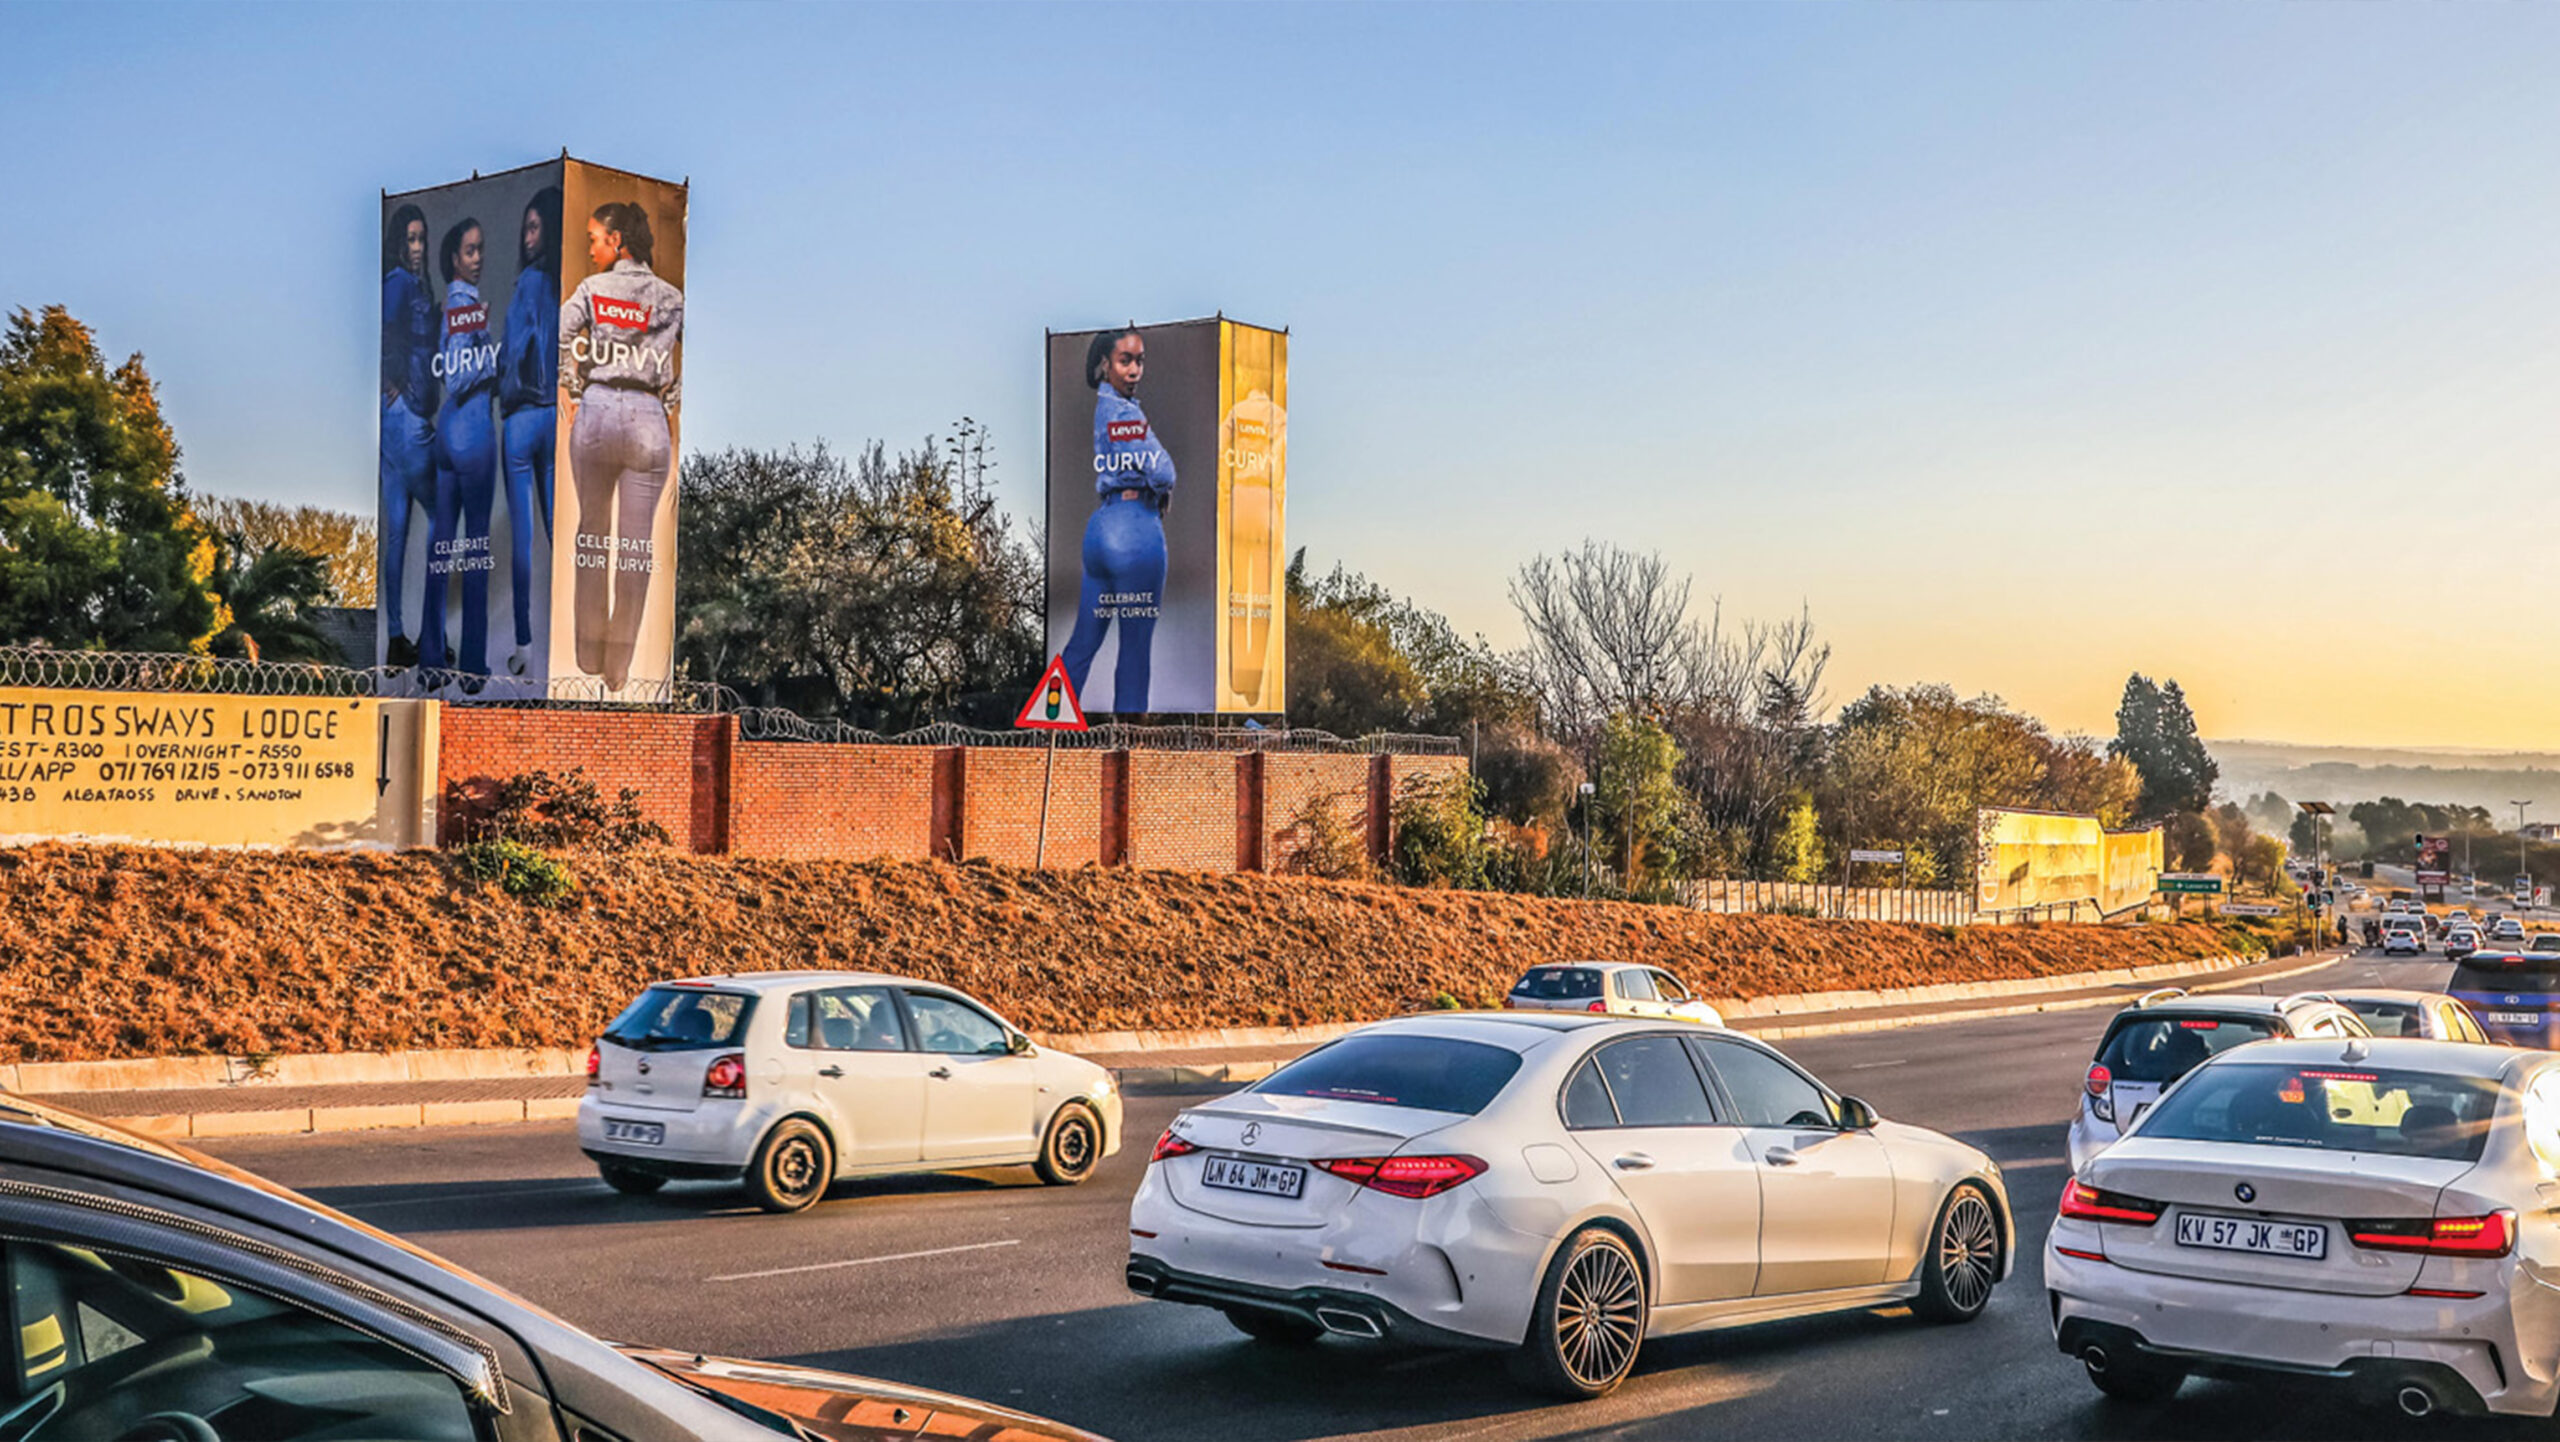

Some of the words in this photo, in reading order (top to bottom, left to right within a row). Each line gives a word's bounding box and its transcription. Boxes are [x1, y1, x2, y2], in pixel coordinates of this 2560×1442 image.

[431, 342, 502, 378] CURVY
[571, 335, 669, 374] CURVY
[1093, 451, 1161, 472] CURVY
[1225, 448, 1279, 472] CURVY
[434, 535, 490, 555] CELEBRATE
[577, 533, 654, 553] CELEBRATE
[429, 559, 455, 575] YOUR
[456, 555, 496, 572] CURVES
[614, 556, 663, 574] URVES
[1098, 592, 1154, 605] CELEBRATE
[1092, 606, 1119, 619] YOUR
[1120, 606, 1161, 618] CURVES
[0, 703, 215, 738] TROSSWAYS
[242, 708, 338, 739] LODGE
[63, 787, 155, 802] ALBATROSS
[237, 788, 302, 801] SANDTON
[1207, 1161, 1226, 1182] LN
[1229, 1164, 1246, 1185] 64
[1278, 1170, 1298, 1192] GP
[2181, 1217, 2206, 1242] KV
[2213, 1221, 2238, 1245] 57
[2247, 1224, 2273, 1249] JK
[2293, 1229, 2319, 1253] GP
